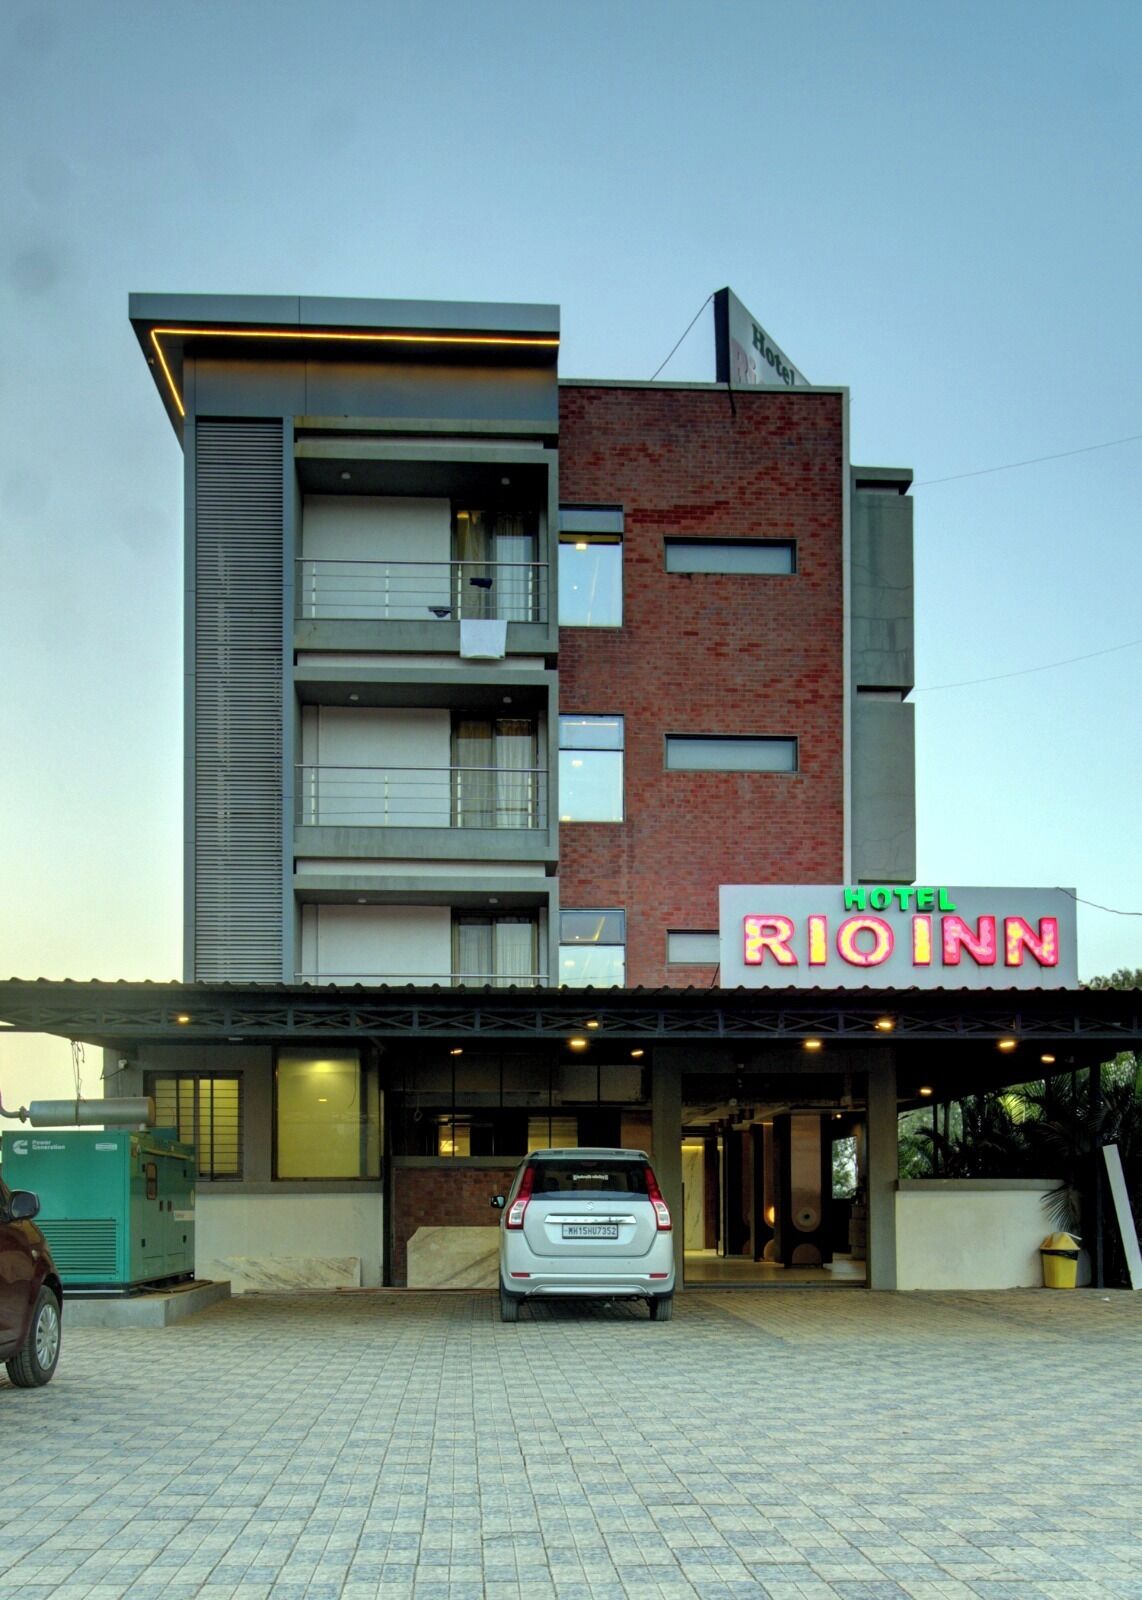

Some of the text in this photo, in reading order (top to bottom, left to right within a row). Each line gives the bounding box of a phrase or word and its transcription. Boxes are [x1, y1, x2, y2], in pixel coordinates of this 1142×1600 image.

[751, 322, 795, 386] Hotel
[843, 887, 957, 912] HOTEL
[743, 914, 1059, 968] RIO INN
[568, 1226, 617, 1235] MH15HU7352
